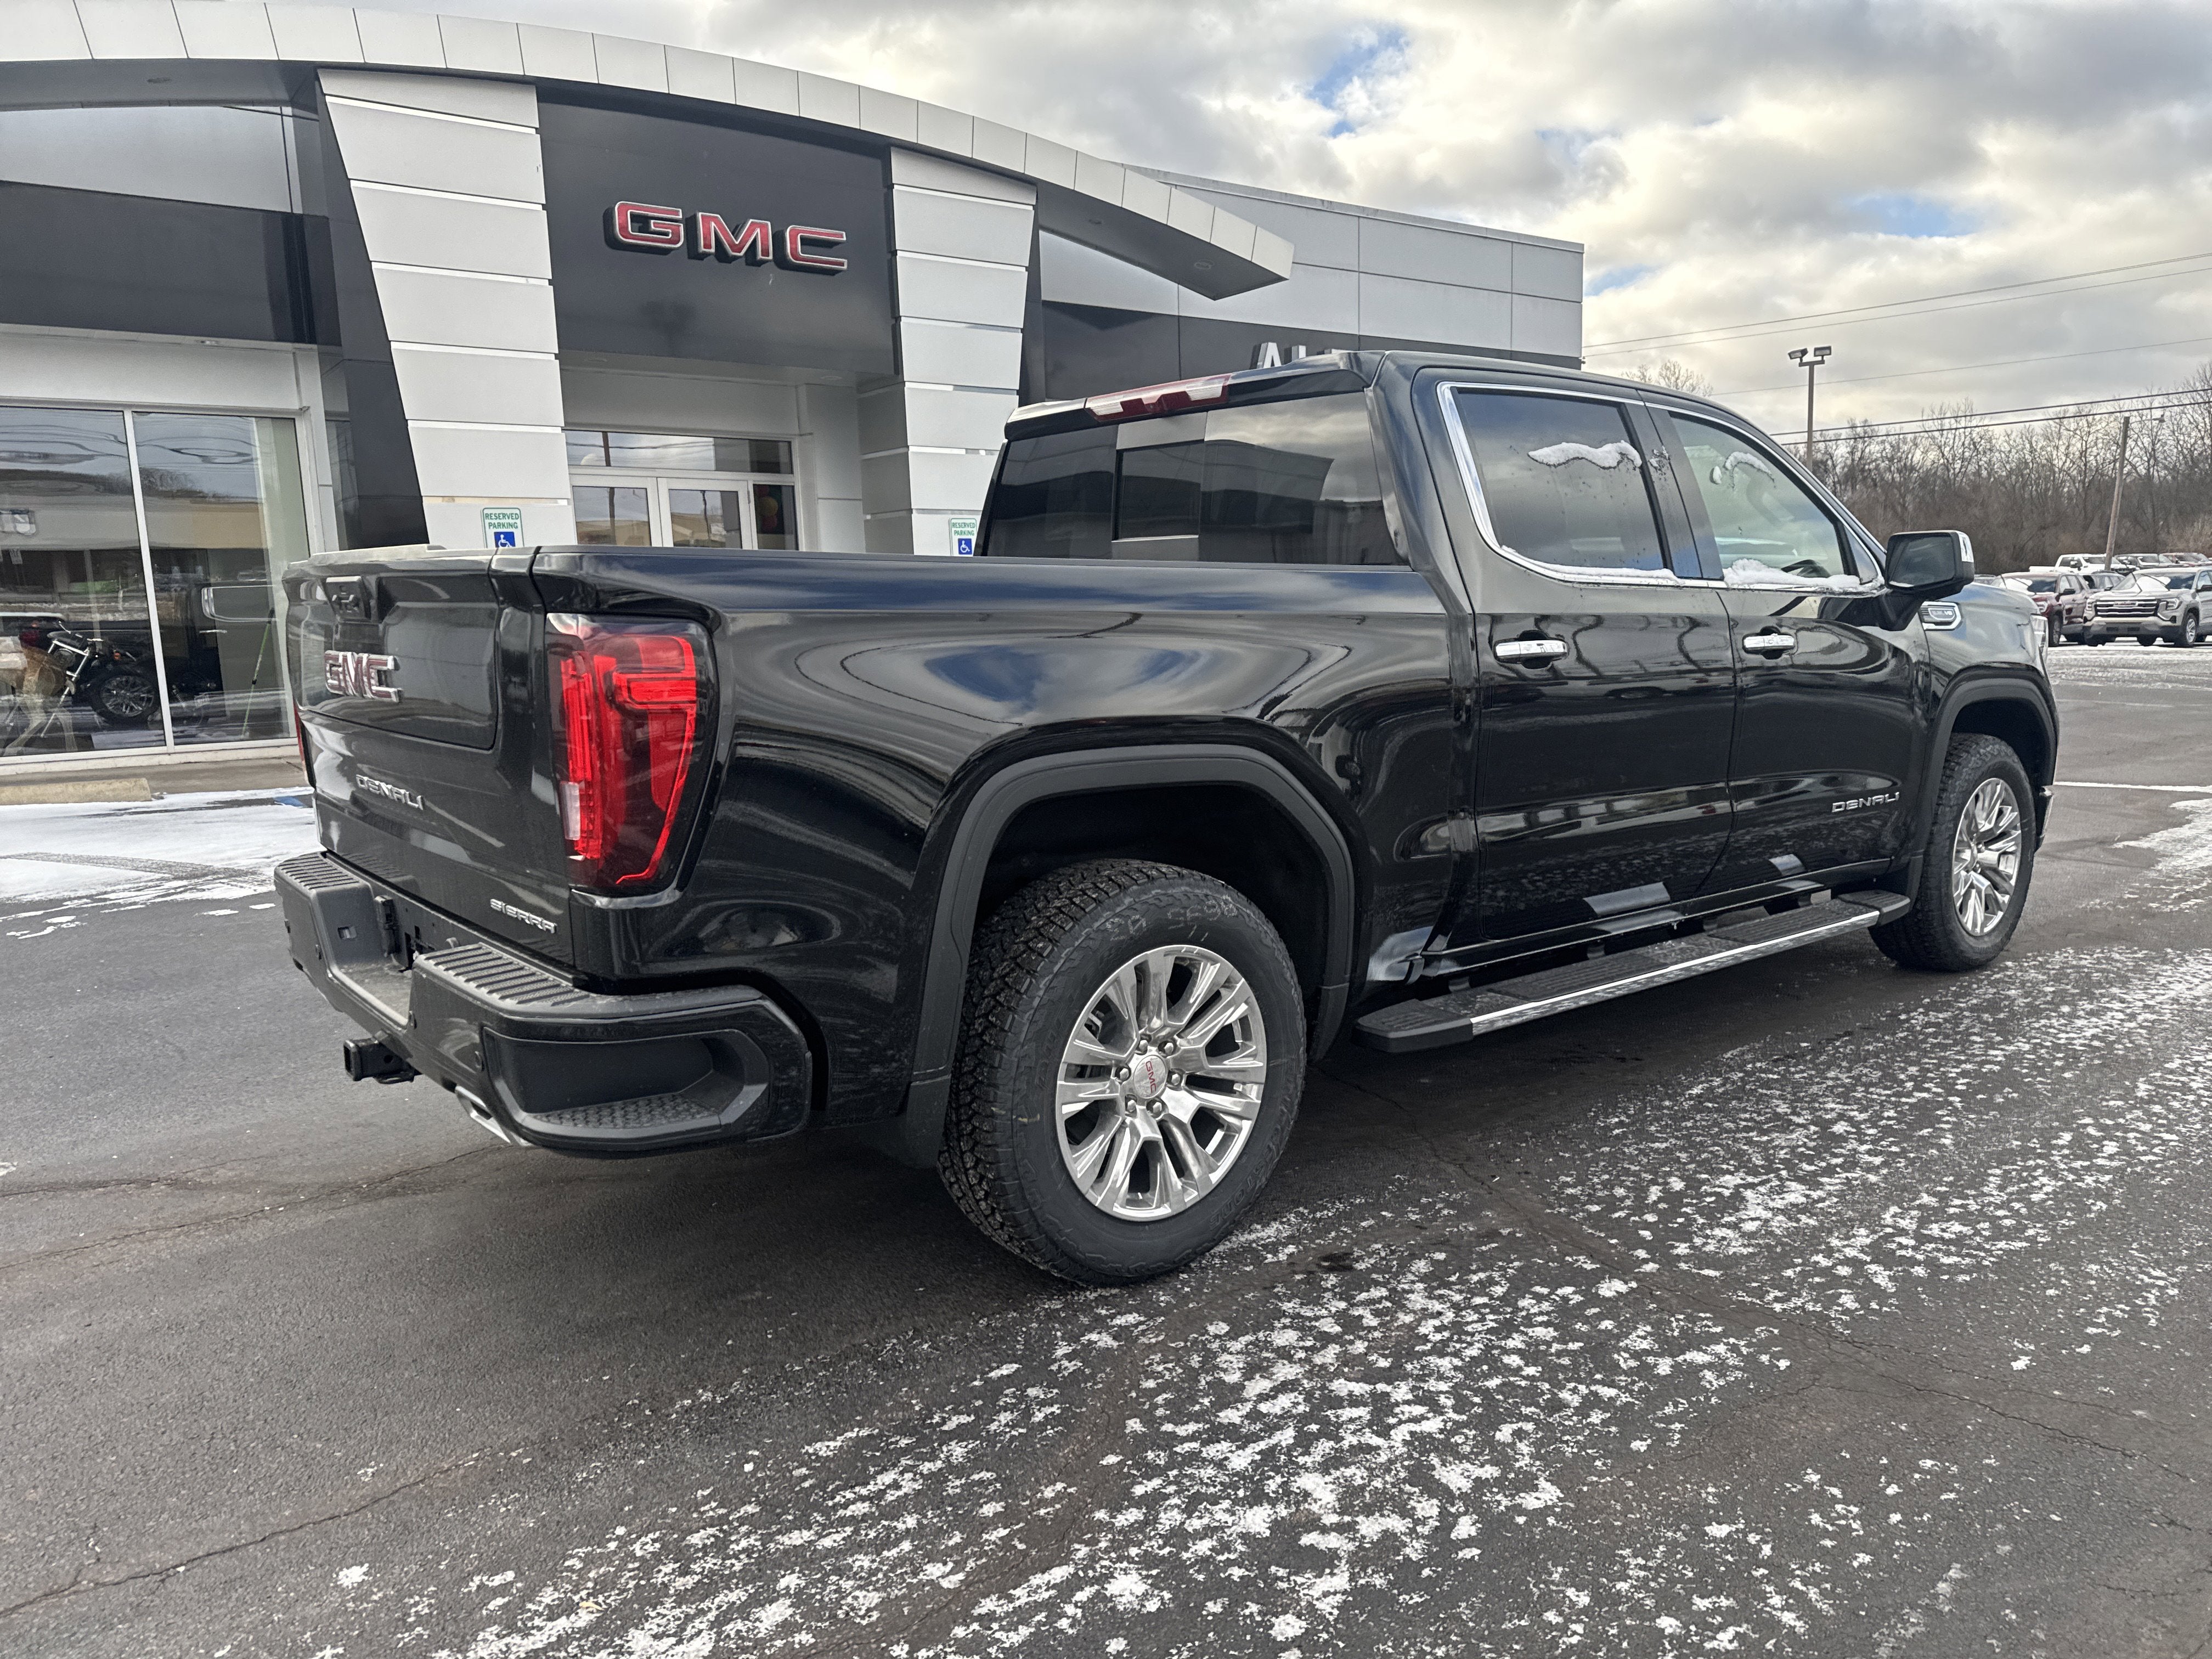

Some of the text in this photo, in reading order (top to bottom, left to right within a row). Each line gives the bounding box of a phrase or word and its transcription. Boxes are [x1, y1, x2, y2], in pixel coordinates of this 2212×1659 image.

[615, 201, 848, 270] GMC
[324, 650, 401, 703] GMC
[356, 774, 424, 811] DENALI
[1832, 792, 1900, 812] DENALI
[490, 899, 556, 934] SIERRA
[1145, 1060, 1157, 1094] GMC
